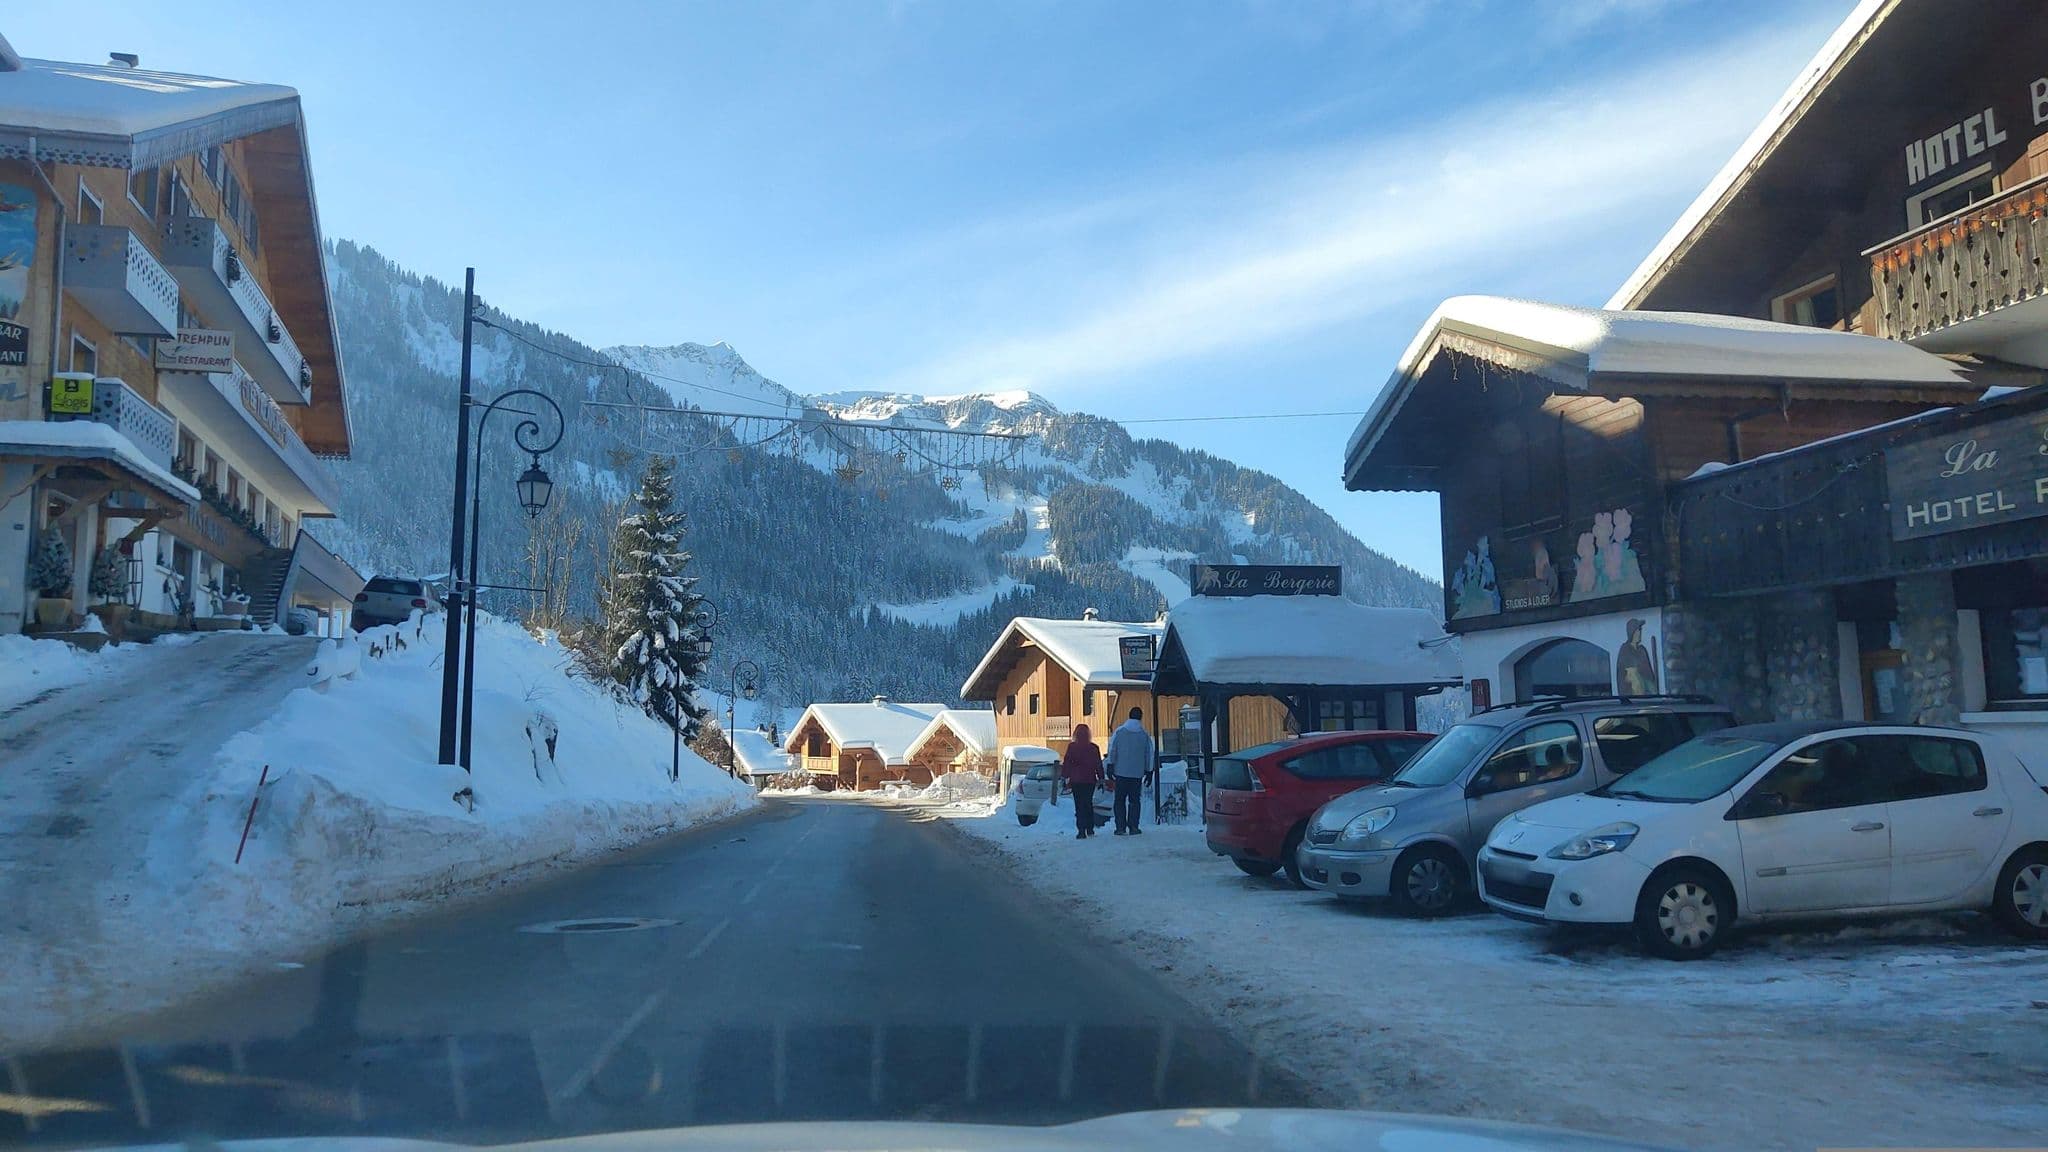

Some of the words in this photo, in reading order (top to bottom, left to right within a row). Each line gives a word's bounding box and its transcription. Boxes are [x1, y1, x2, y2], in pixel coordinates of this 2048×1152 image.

[1906, 107, 2007, 186] HOTEL
[178, 355, 231, 367] RESTAURANT
[1940, 440, 2000, 478] La
[1907, 490, 2016, 528] HOTEL
[1223, 569, 1249, 589] La
[1264, 570, 1336, 595] Bergerie
